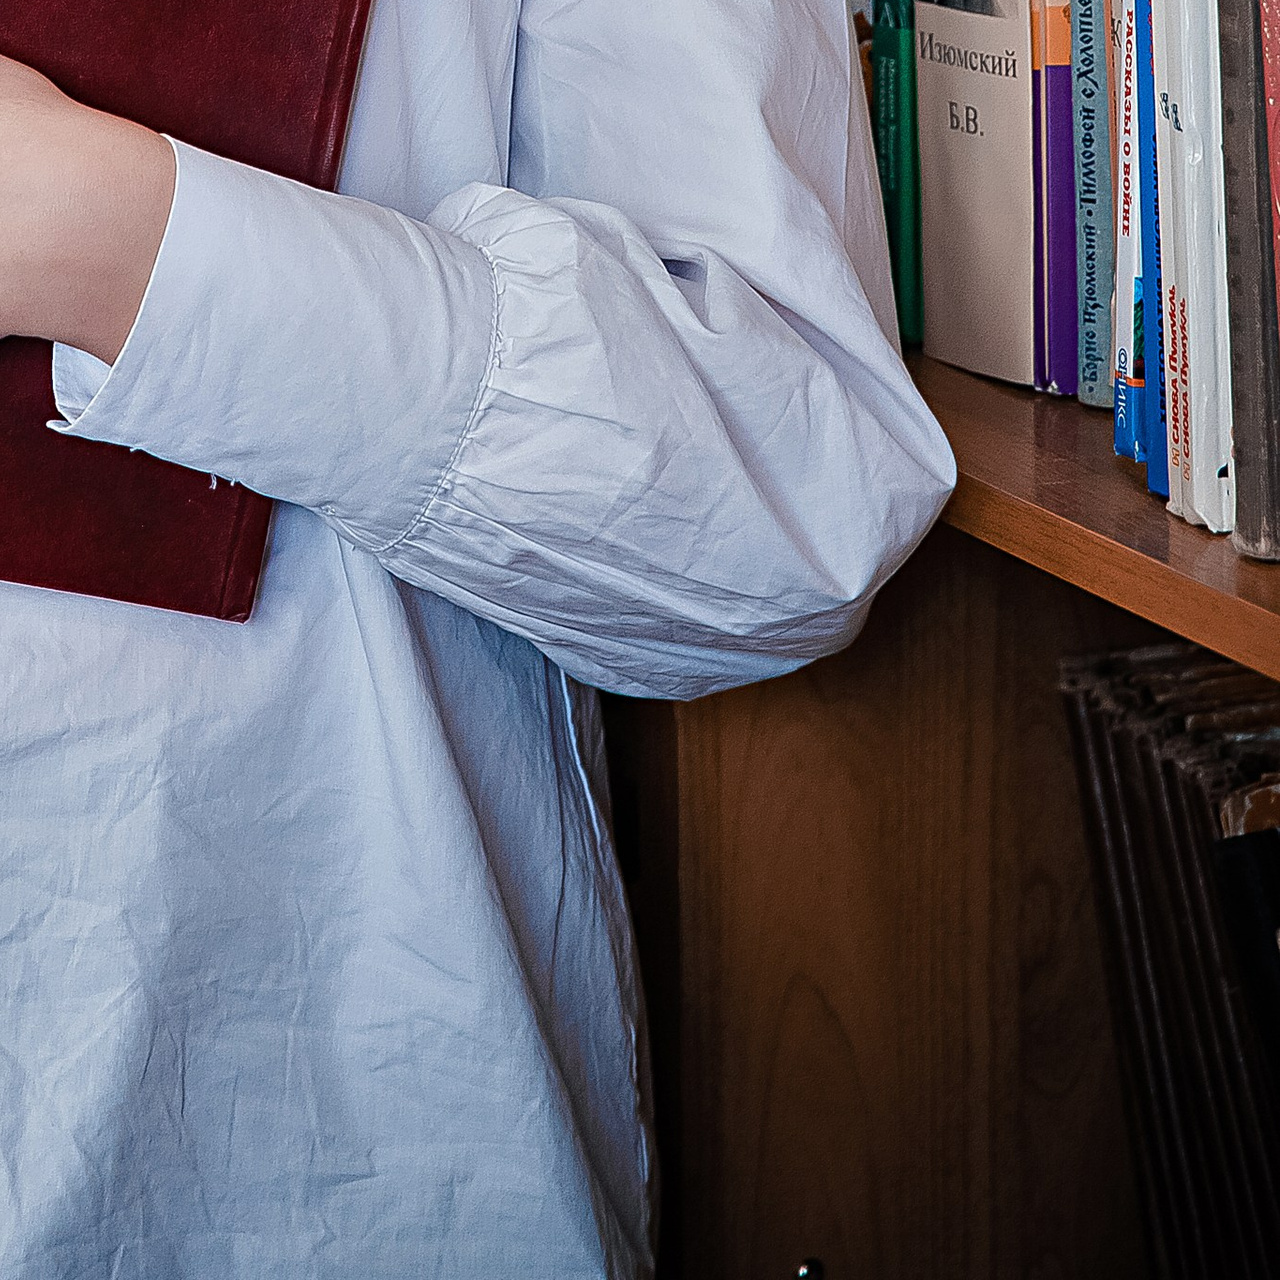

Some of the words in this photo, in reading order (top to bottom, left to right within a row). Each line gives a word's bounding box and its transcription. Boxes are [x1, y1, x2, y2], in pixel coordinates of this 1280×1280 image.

[920, 31, 1017, 78] Изюмский
[1124, 9, 1134, 134] РАССКАЗЫ
[948, 101, 984, 136] Б.В.
[1123, 141, 1131, 155] О
[1122, 161, 1132, 237] ВОЙНЕ
[1117, 347, 1128, 428] ОНИКС
